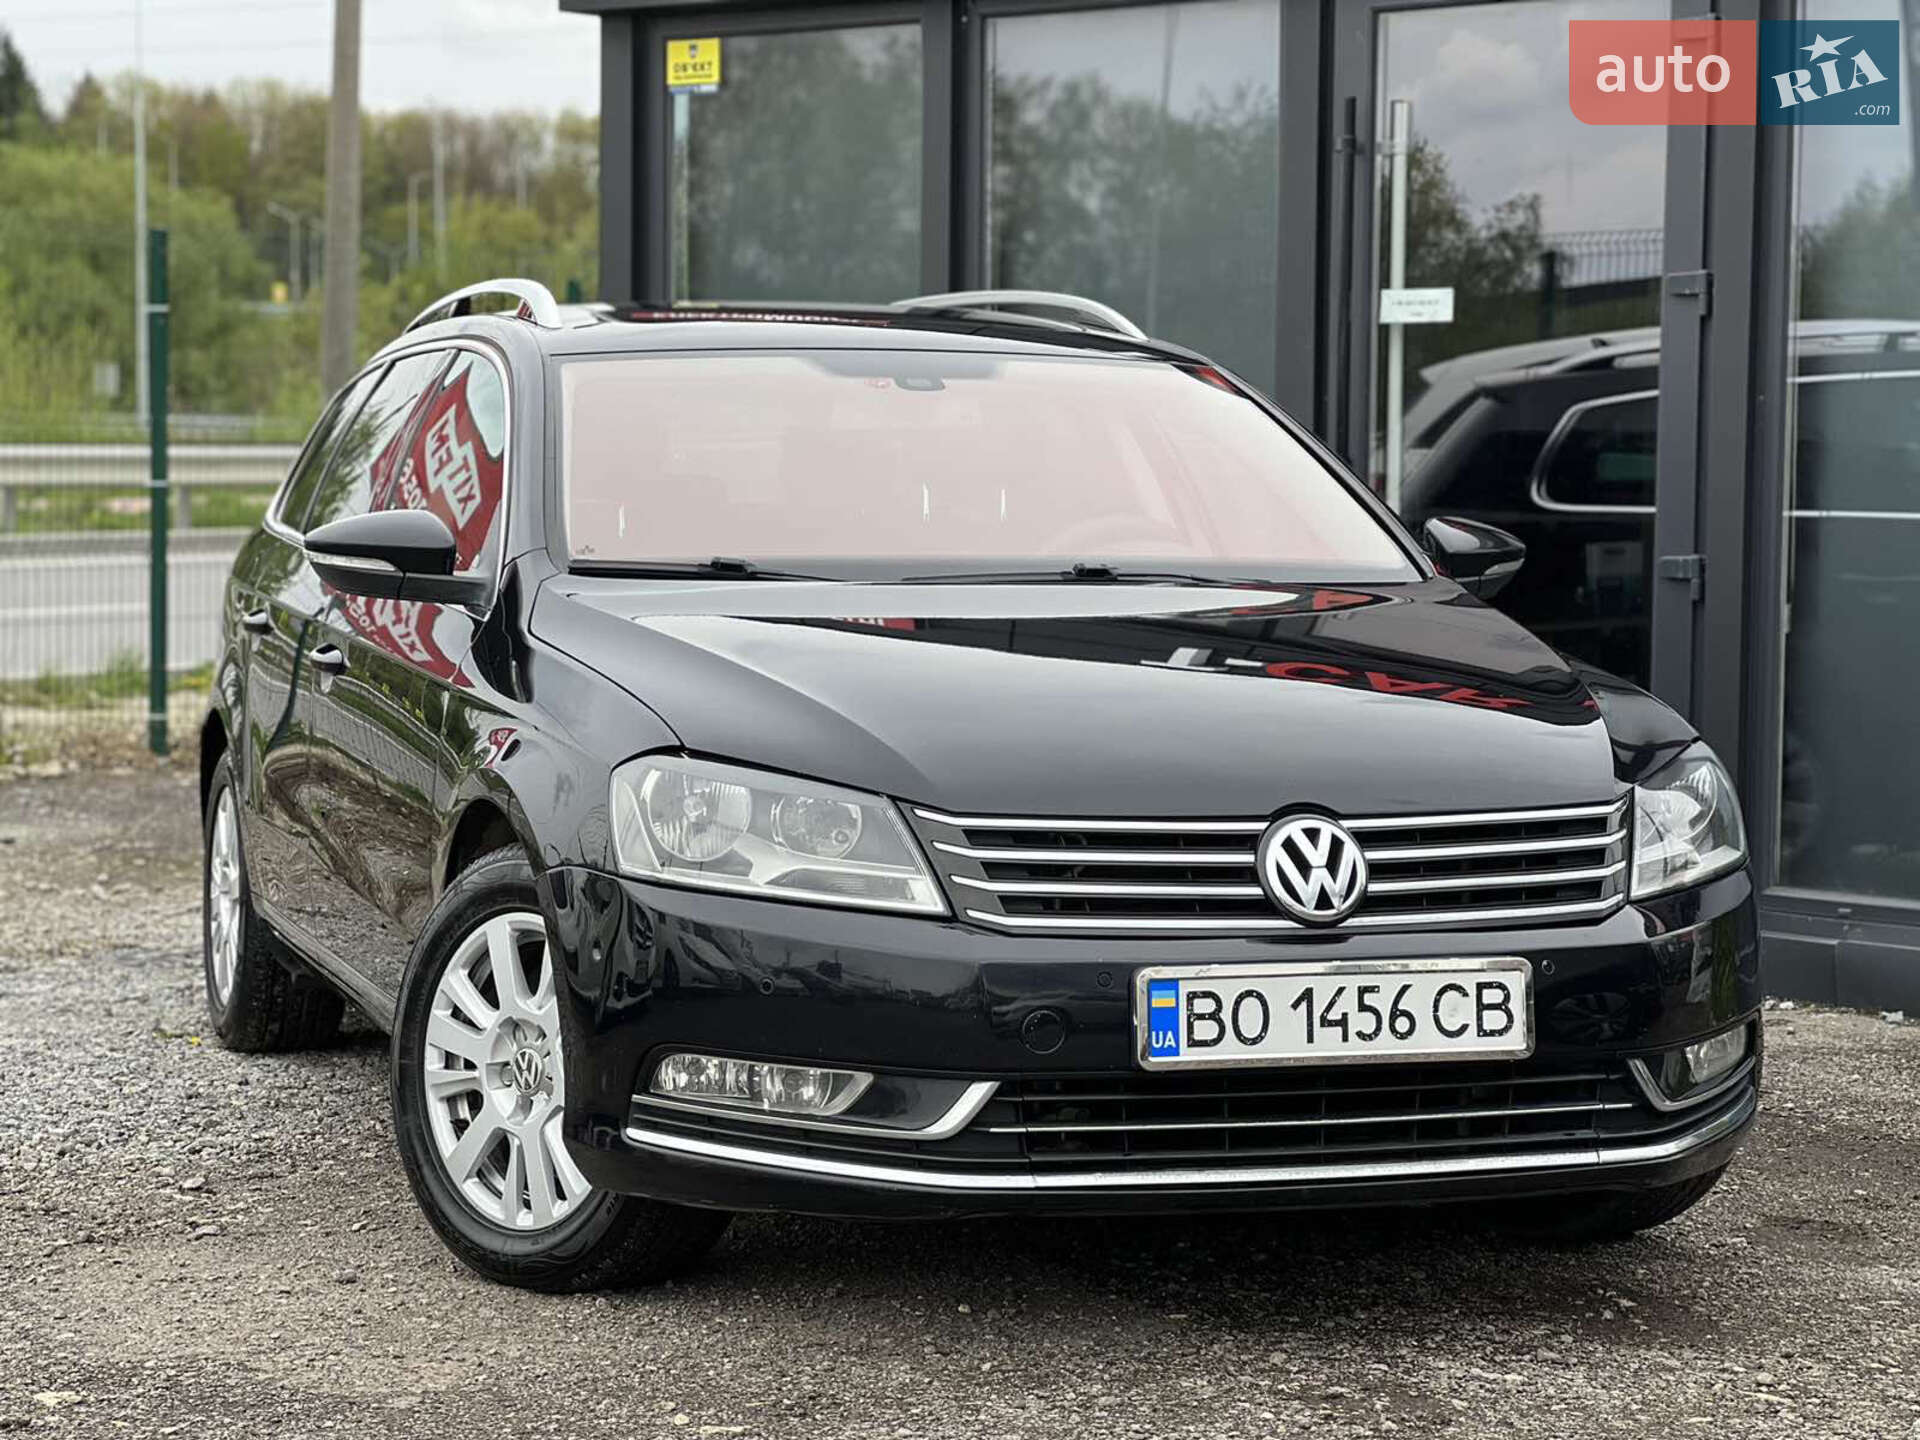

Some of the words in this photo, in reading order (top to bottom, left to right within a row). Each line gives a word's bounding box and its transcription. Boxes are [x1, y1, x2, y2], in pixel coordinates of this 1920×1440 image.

[1270, 817, 1361, 914] VW
[1151, 1030, 1177, 1049] UA
[1186, 988, 1270, 1049] BO
[1291, 983, 1417, 1044] 1456
[1432, 980, 1515, 1039] CB
